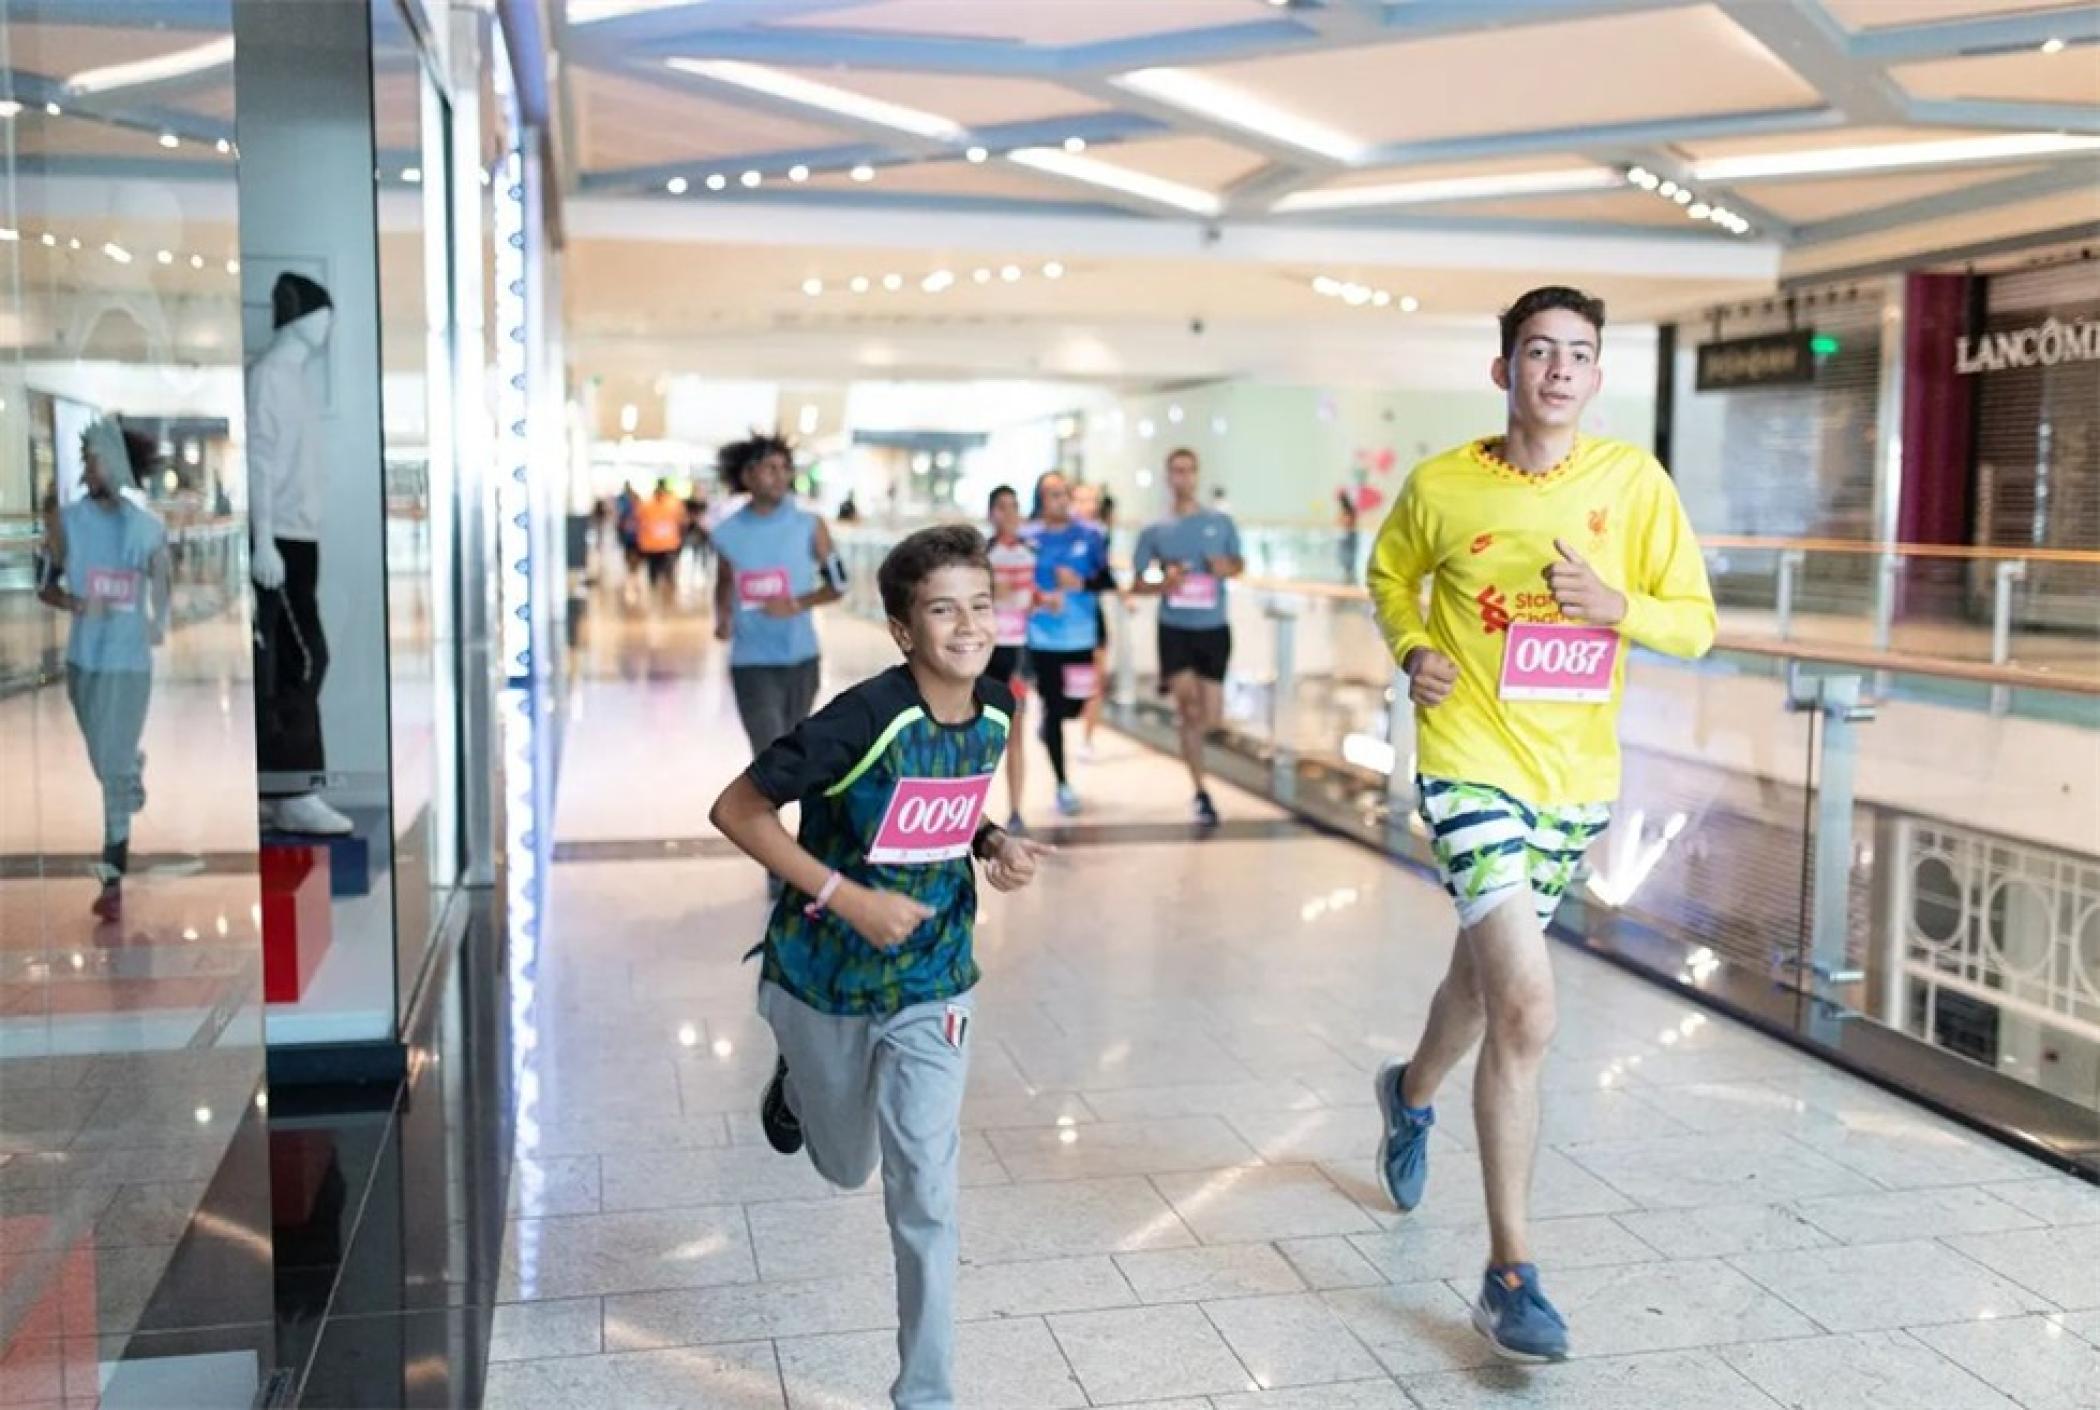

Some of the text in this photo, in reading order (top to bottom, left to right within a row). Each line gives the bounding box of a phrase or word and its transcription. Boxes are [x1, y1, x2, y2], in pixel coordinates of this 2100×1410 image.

[1955, 316, 2100, 374] LANCÔM
[1515, 638, 1609, 675] 0087
[897, 793, 977, 834] 0091
